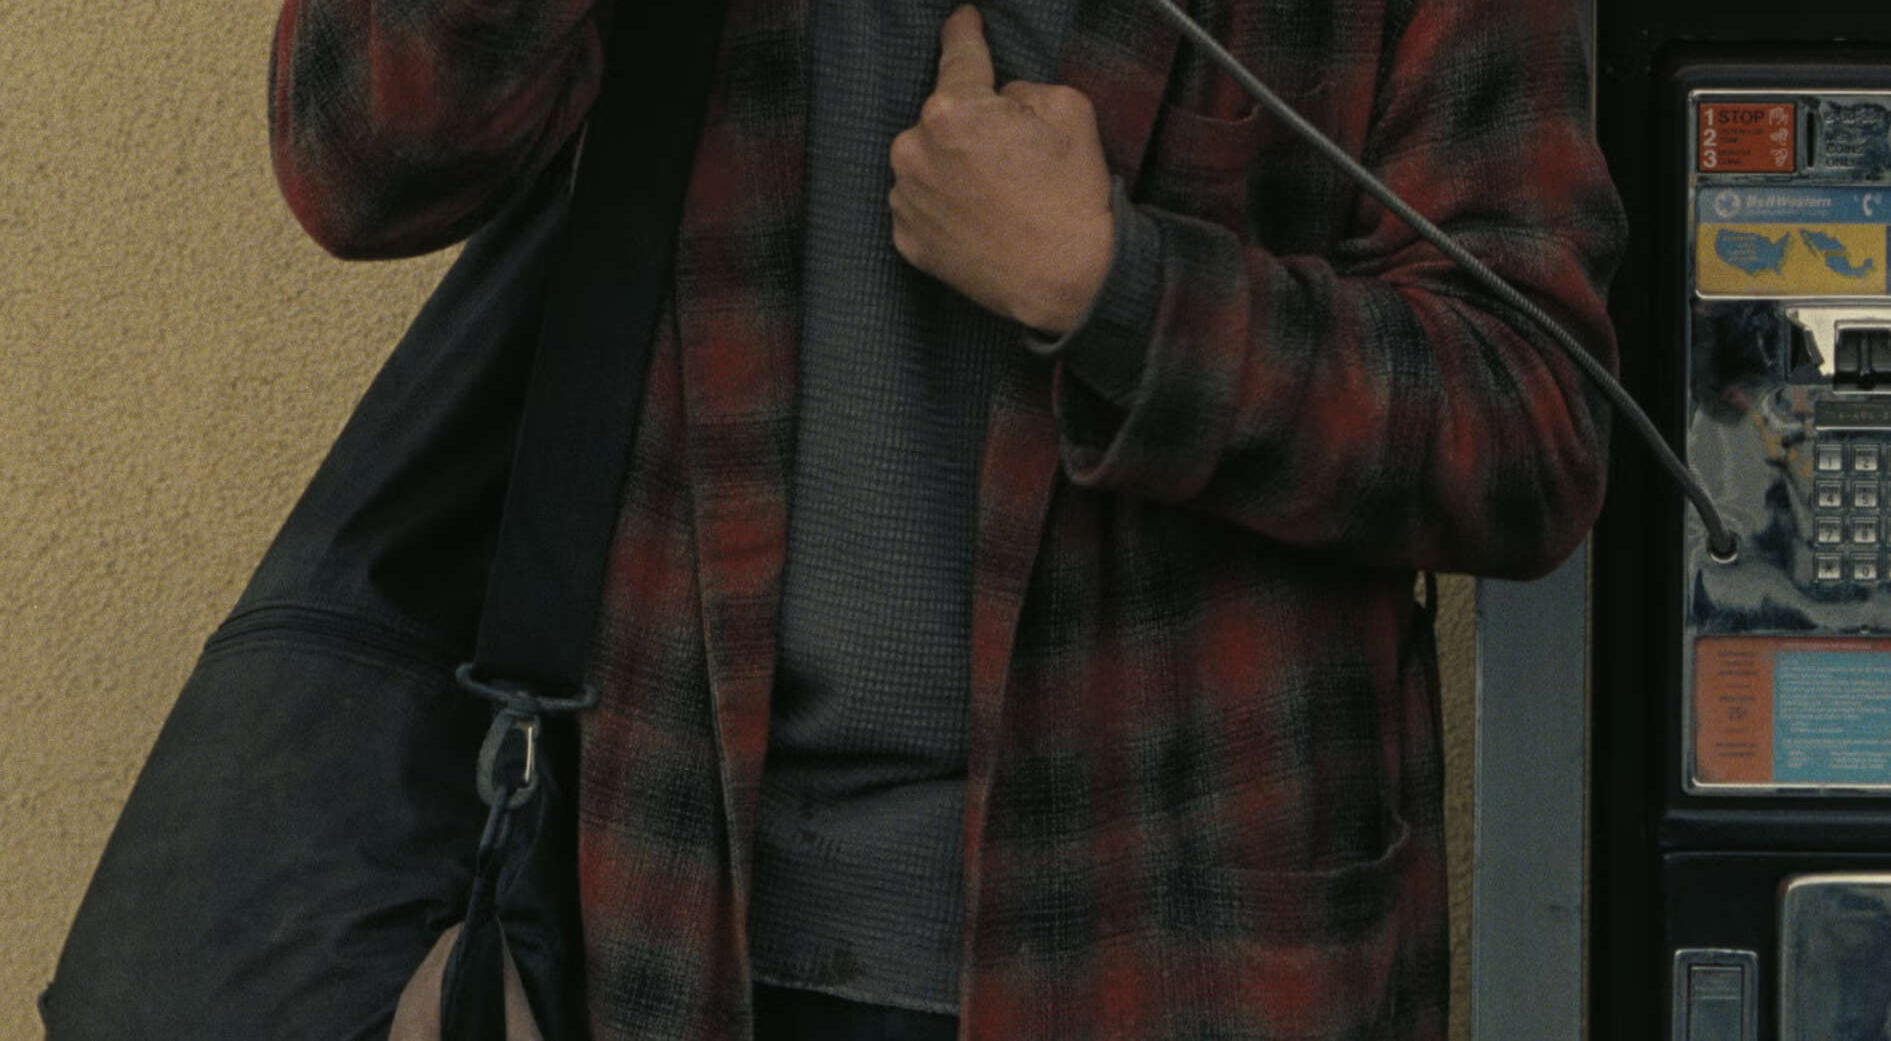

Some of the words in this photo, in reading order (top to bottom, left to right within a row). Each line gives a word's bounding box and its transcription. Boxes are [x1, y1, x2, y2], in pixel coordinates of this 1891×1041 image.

[1704, 108, 1713, 126] 1
[1719, 110, 1765, 124] STOP
[1704, 128, 1717, 147] 2
[1704, 150, 1717, 168] 3
